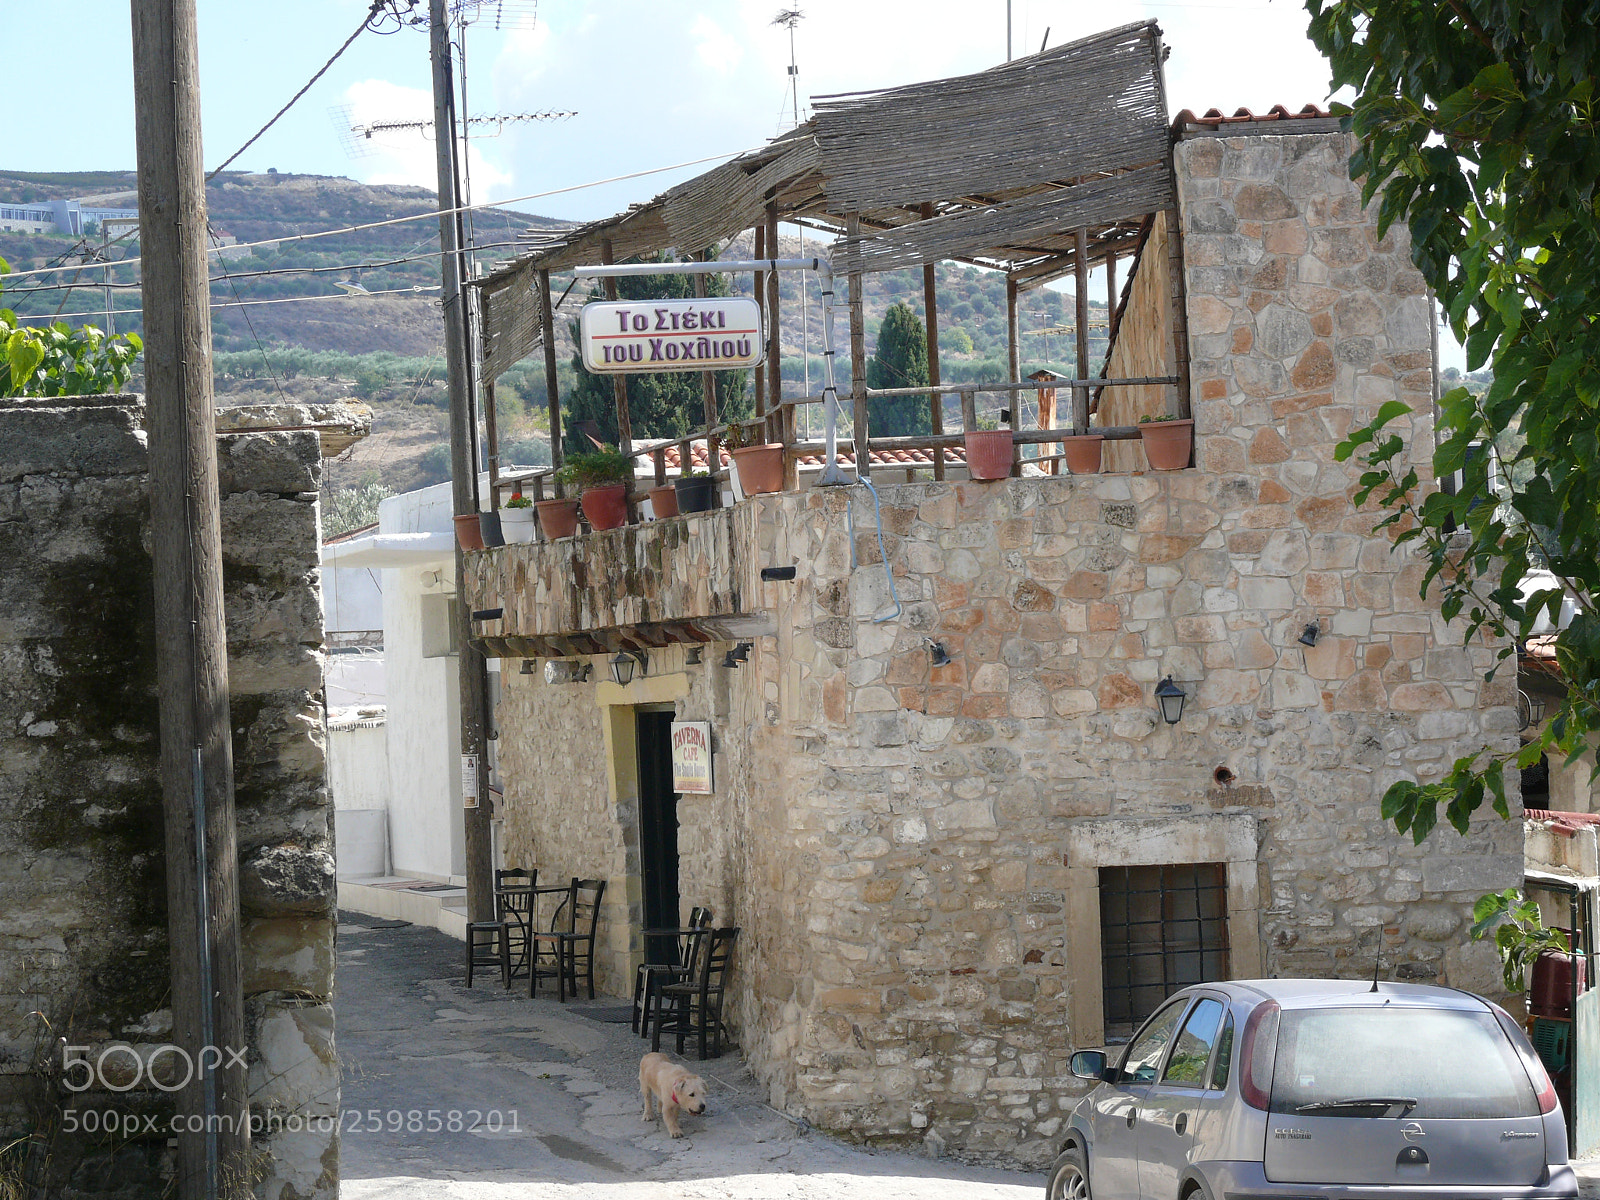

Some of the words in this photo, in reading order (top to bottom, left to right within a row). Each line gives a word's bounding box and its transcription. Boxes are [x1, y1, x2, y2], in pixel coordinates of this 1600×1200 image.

[616, 309, 649, 332] Το
[654, 306, 726, 330] Στέκι
[603, 344, 643, 363] του
[649, 334, 751, 361] Χοχλιού
[673, 726, 707, 752] TAVERNA
